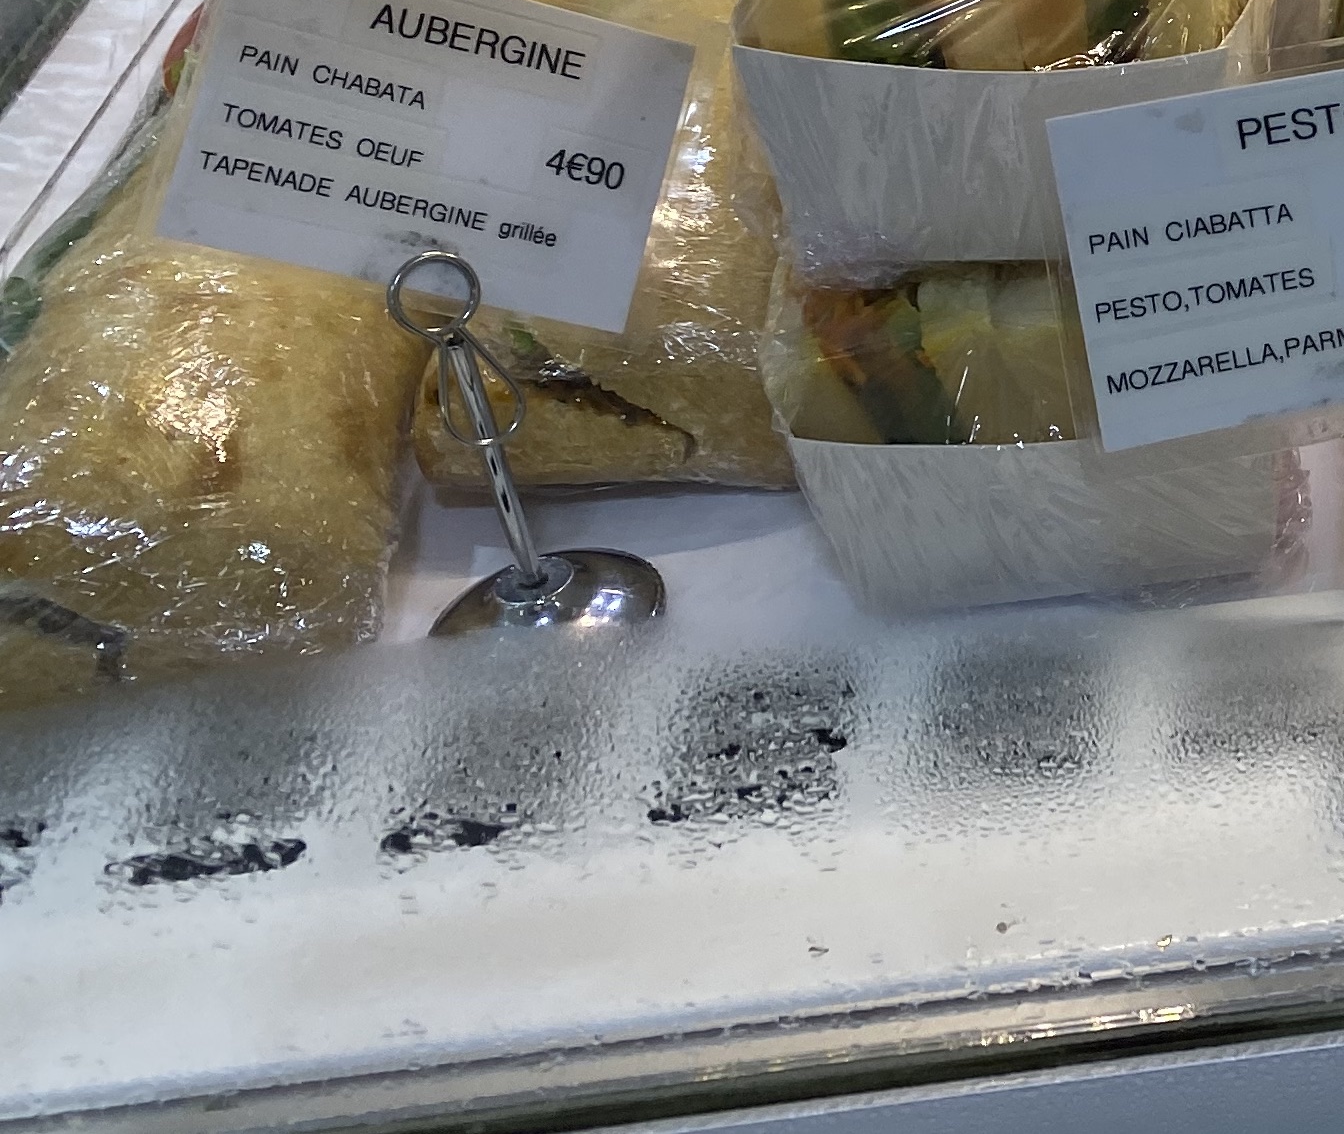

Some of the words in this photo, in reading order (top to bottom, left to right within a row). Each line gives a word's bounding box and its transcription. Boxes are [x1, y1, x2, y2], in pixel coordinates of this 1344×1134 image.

[369, 3, 586, 81] AUBERGINE
[238, 44, 299, 76] PAIN
[312, 64, 427, 110] CHABATA
[222, 102, 344, 152] TOMATES
[356, 136, 426, 169] OEUF
[200, 150, 332, 198] TAPENADE
[344, 184, 488, 233] AUBERGINE
[499, 218, 558, 248] grillée
[544, 147, 626, 191] 4€90
[1087, 226, 1150, 256] PAIN
[1164, 202, 1294, 244] CIABATTA
[1094, 267, 1316, 324] PESTO,TOMATES
